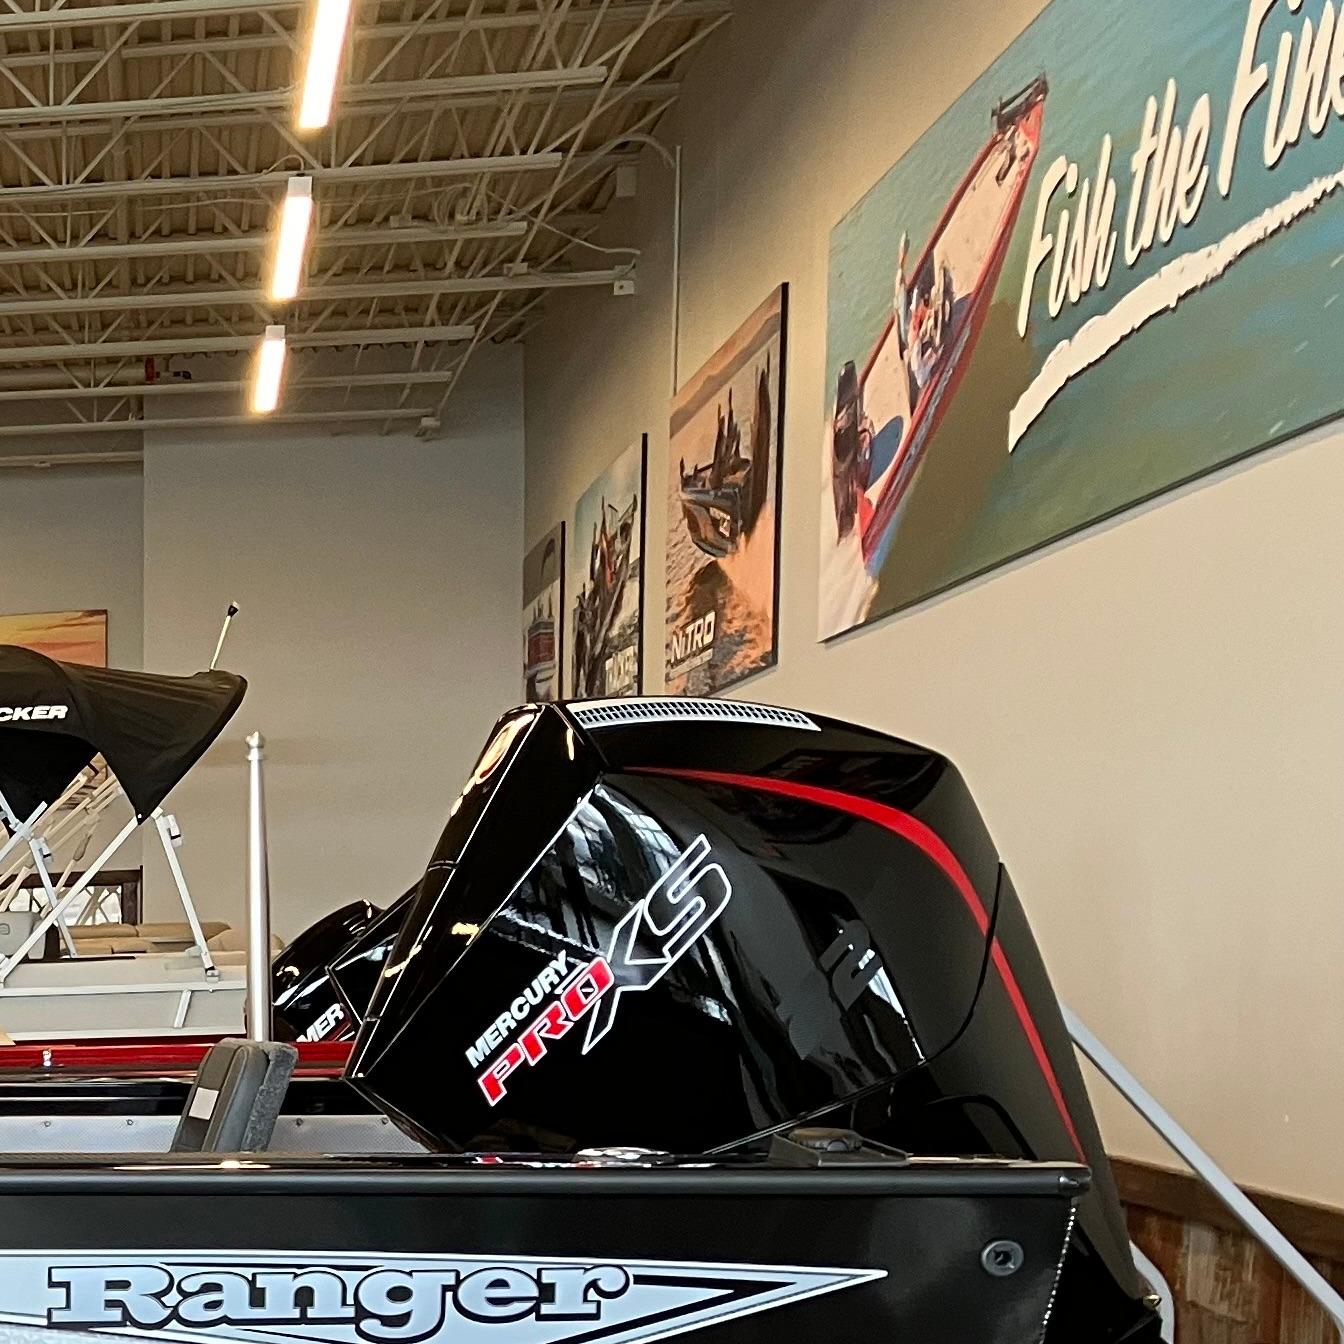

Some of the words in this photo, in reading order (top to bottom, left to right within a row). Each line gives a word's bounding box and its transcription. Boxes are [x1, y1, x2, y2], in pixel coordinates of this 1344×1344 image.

[1017, 133, 1117, 338] Fish
[1125, 77, 1211, 266] the
[295, 1003, 345, 1042] MER
[465, 950, 569, 1068] MERCURY
[478, 956, 614, 1106] PRO
[47, 1265, 630, 1344] Ranger
